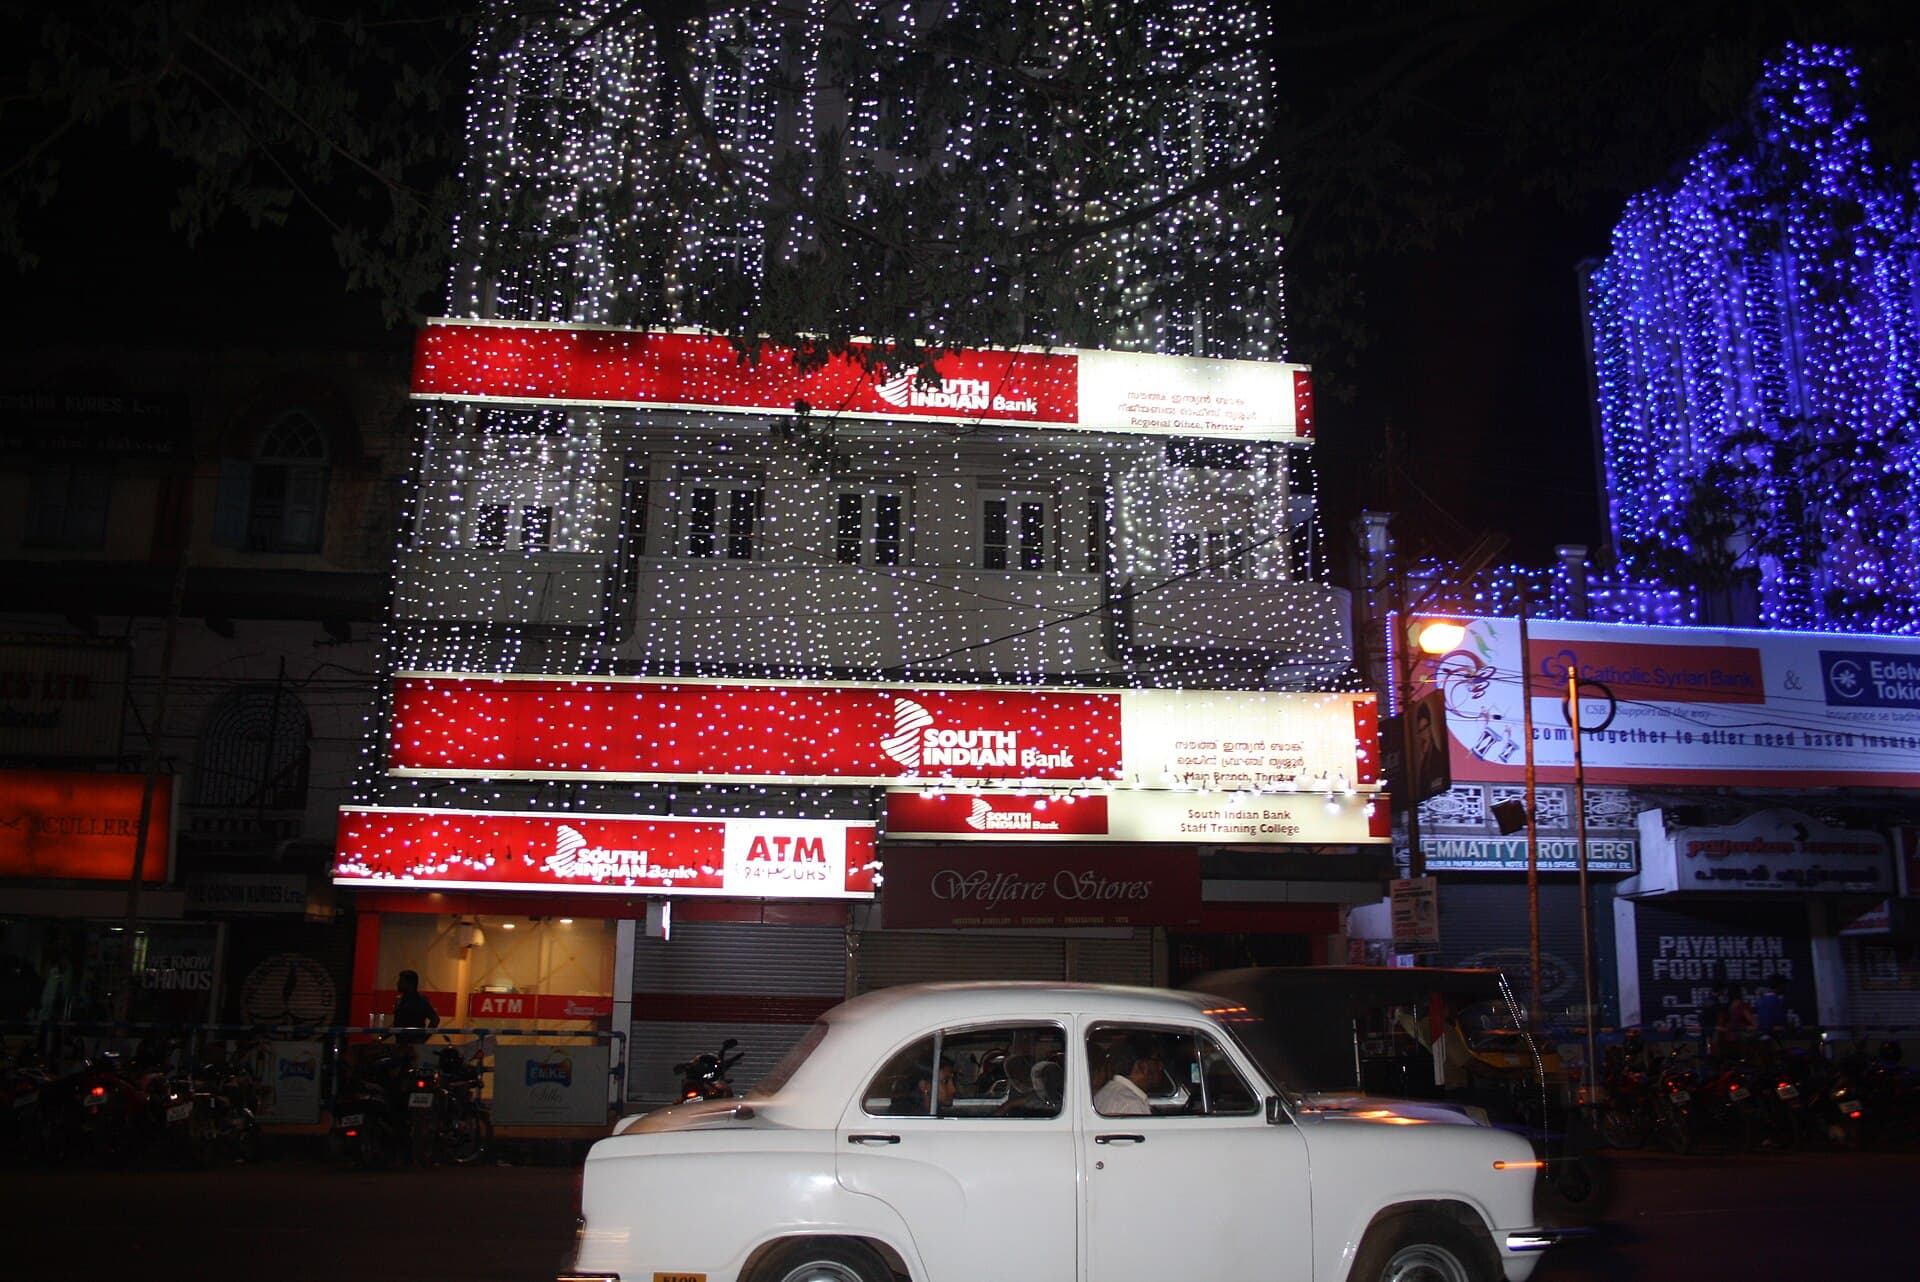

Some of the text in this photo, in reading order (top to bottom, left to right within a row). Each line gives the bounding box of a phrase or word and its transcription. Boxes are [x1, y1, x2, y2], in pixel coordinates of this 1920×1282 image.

[911, 392, 1037, 413] INDIAN Bank
[1130, 416, 1171, 428] Regional
[1580, 664, 1650, 684] Catholic
[1653, 667, 1708, 688] Syrian
[1712, 670, 1754, 687] Bank
[923, 728, 1017, 749] SOUTH
[1531, 727, 1579, 741] com
[1587, 728, 1667, 745] together
[1754, 732, 1796, 747] need
[923, 747, 1074, 768] INDIAN Bank
[1186, 771, 1210, 781] Main
[1214, 772, 1252, 782] Branch,
[1188, 809, 1292, 821] South Indian Bank
[1180, 823, 1300, 837] Staff Training College
[578, 848, 648, 864] SOUTH
[746, 836, 827, 863] ATM
[1423, 840, 1629, 860] EMMATTY ROTERS
[930, 868, 1152, 909] Welfare Stores
[1659, 936, 1783, 958] PAYANKAN
[1653, 959, 1793, 981] FOOT WEAR
[480, 998, 523, 1014] ATM
